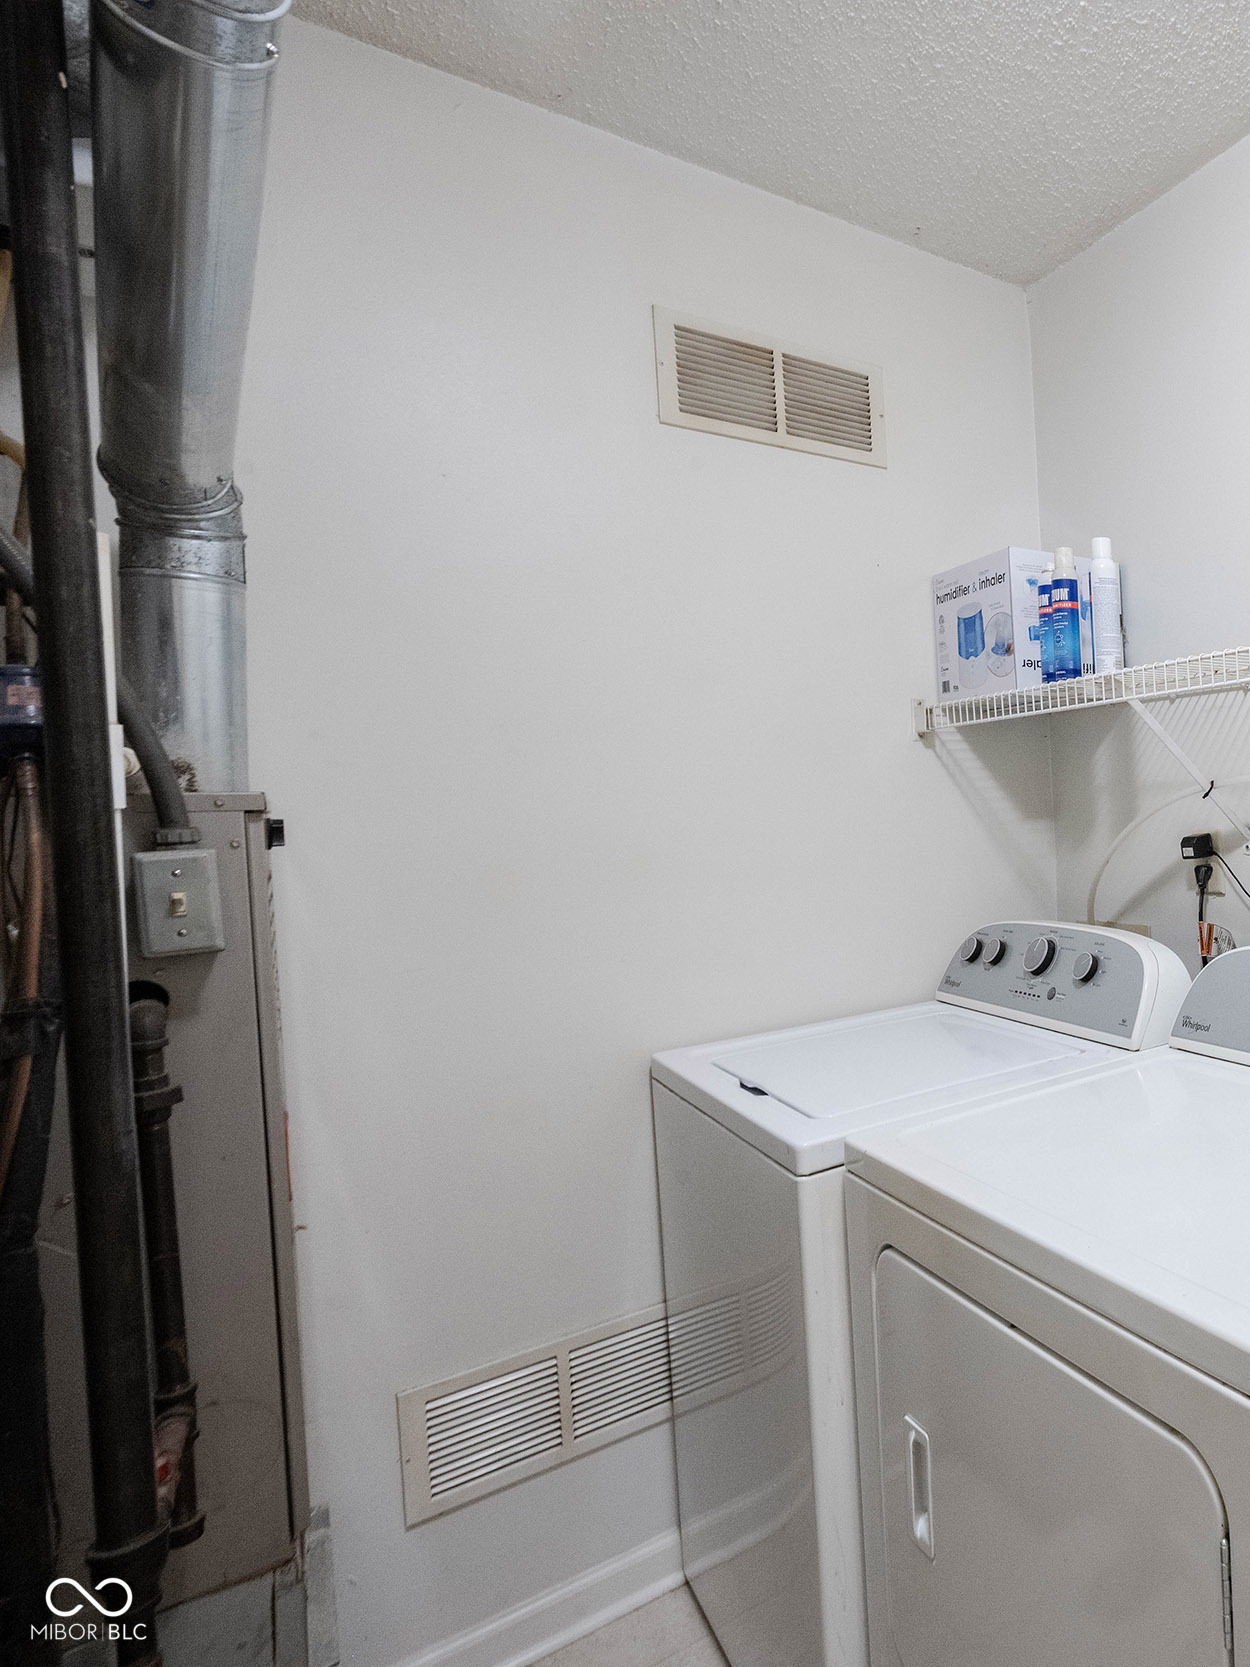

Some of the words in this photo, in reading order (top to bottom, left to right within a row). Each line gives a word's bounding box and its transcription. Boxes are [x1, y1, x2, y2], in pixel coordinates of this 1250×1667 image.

[935, 584, 971, 605] humidifier
[971, 582, 977, 593] &
[978, 572, 1006, 590] inhaler
[1182, 1019, 1212, 1033] Whirlpool
